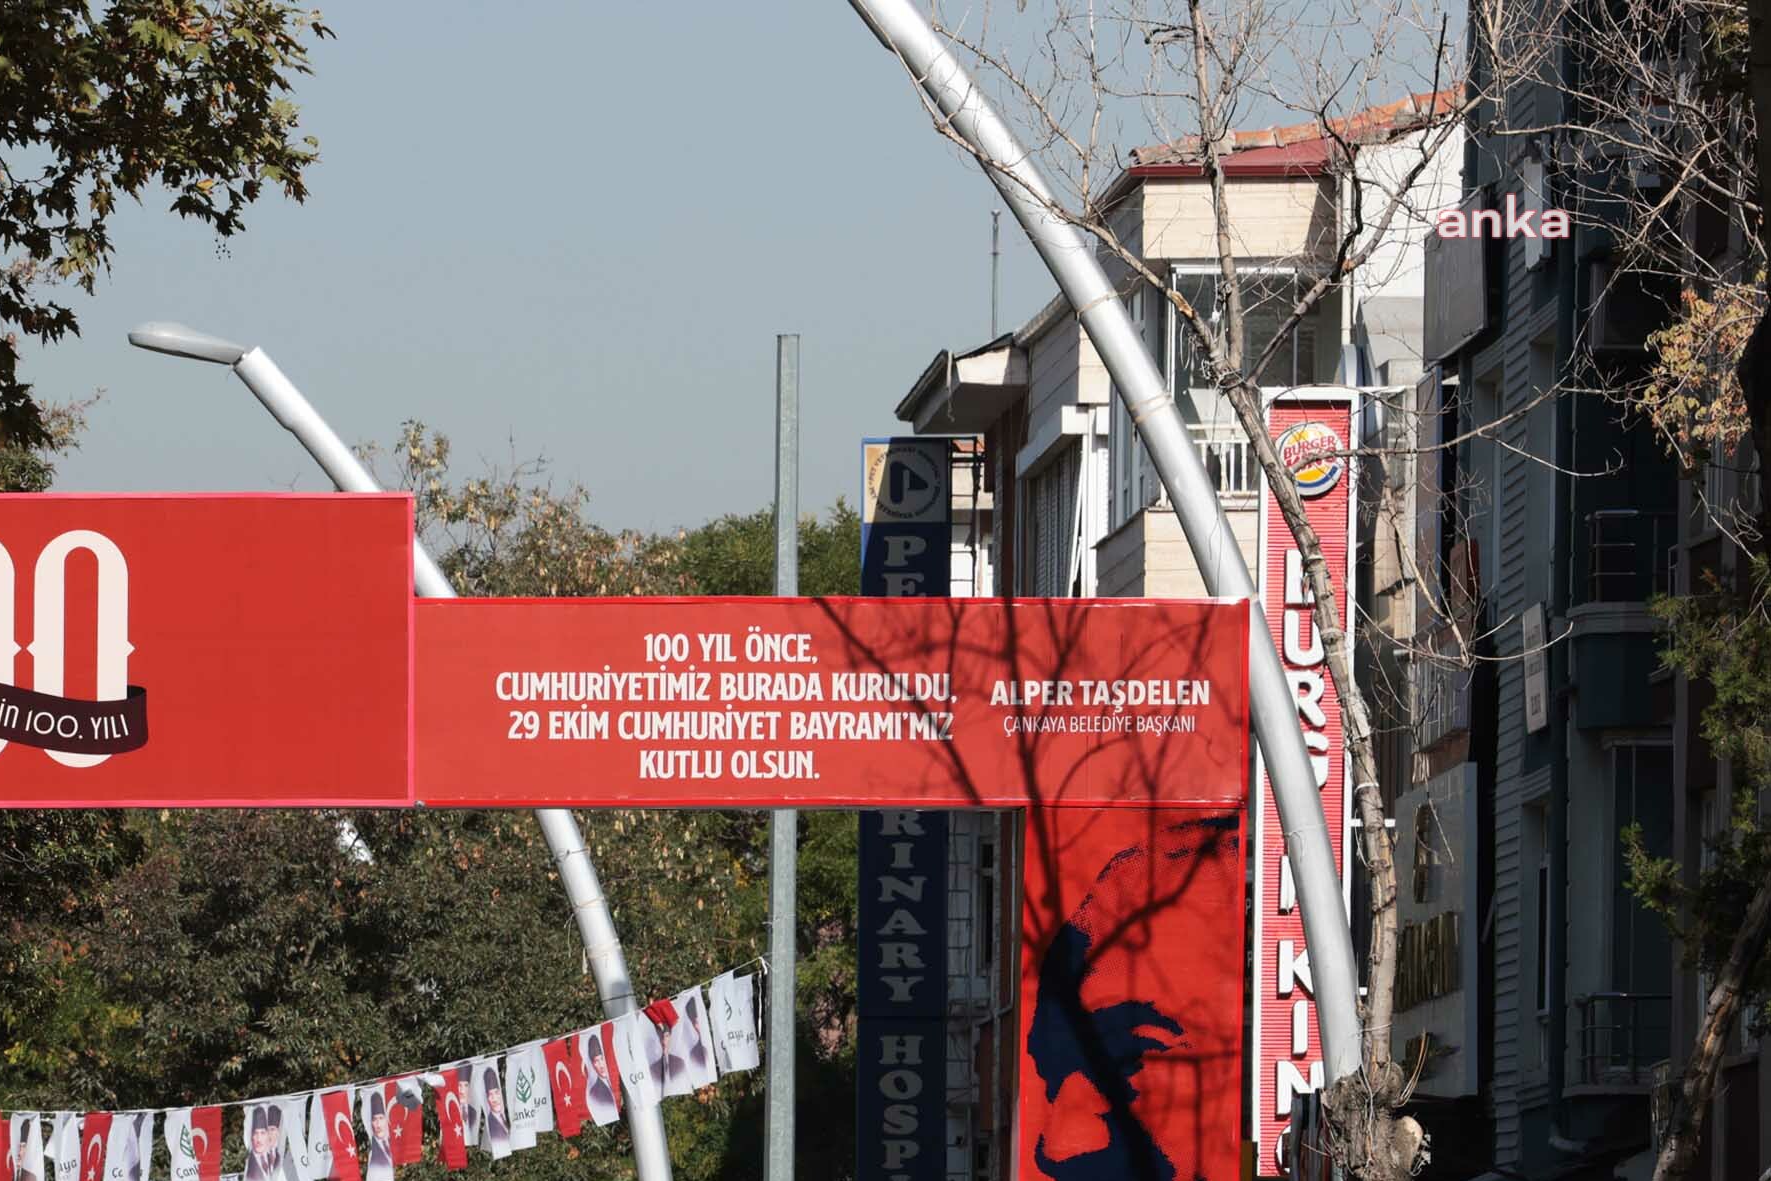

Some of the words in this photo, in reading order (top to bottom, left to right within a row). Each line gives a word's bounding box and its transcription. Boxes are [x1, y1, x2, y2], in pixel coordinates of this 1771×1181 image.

[643, 633, 690, 662] 100
[697, 633, 737, 662] YIL
[745, 626, 818, 664] ÖNCE,
[495, 665, 712, 701] CUMHURİYETİMİZ
[719, 672, 824, 701] BURADA
[831, 672, 958, 703] KURULDU,
[990, 680, 1073, 706] ALPER
[1080, 680, 1210, 713] TAŞDELEN
[90, 714, 130, 741] YILI
[507, 711, 541, 740] 29
[548, 704, 610, 740] EKİM
[617, 704, 782, 740] CUMHURİYET
[1003, 715, 1066, 737] ÇANKAYA
[1070, 712, 1132, 733] BELEDİYE
[1136, 715, 1196, 737] BAŞKANI
[639, 750, 723, 779] KUTLU
[730, 750, 821, 780] OLSUN.
